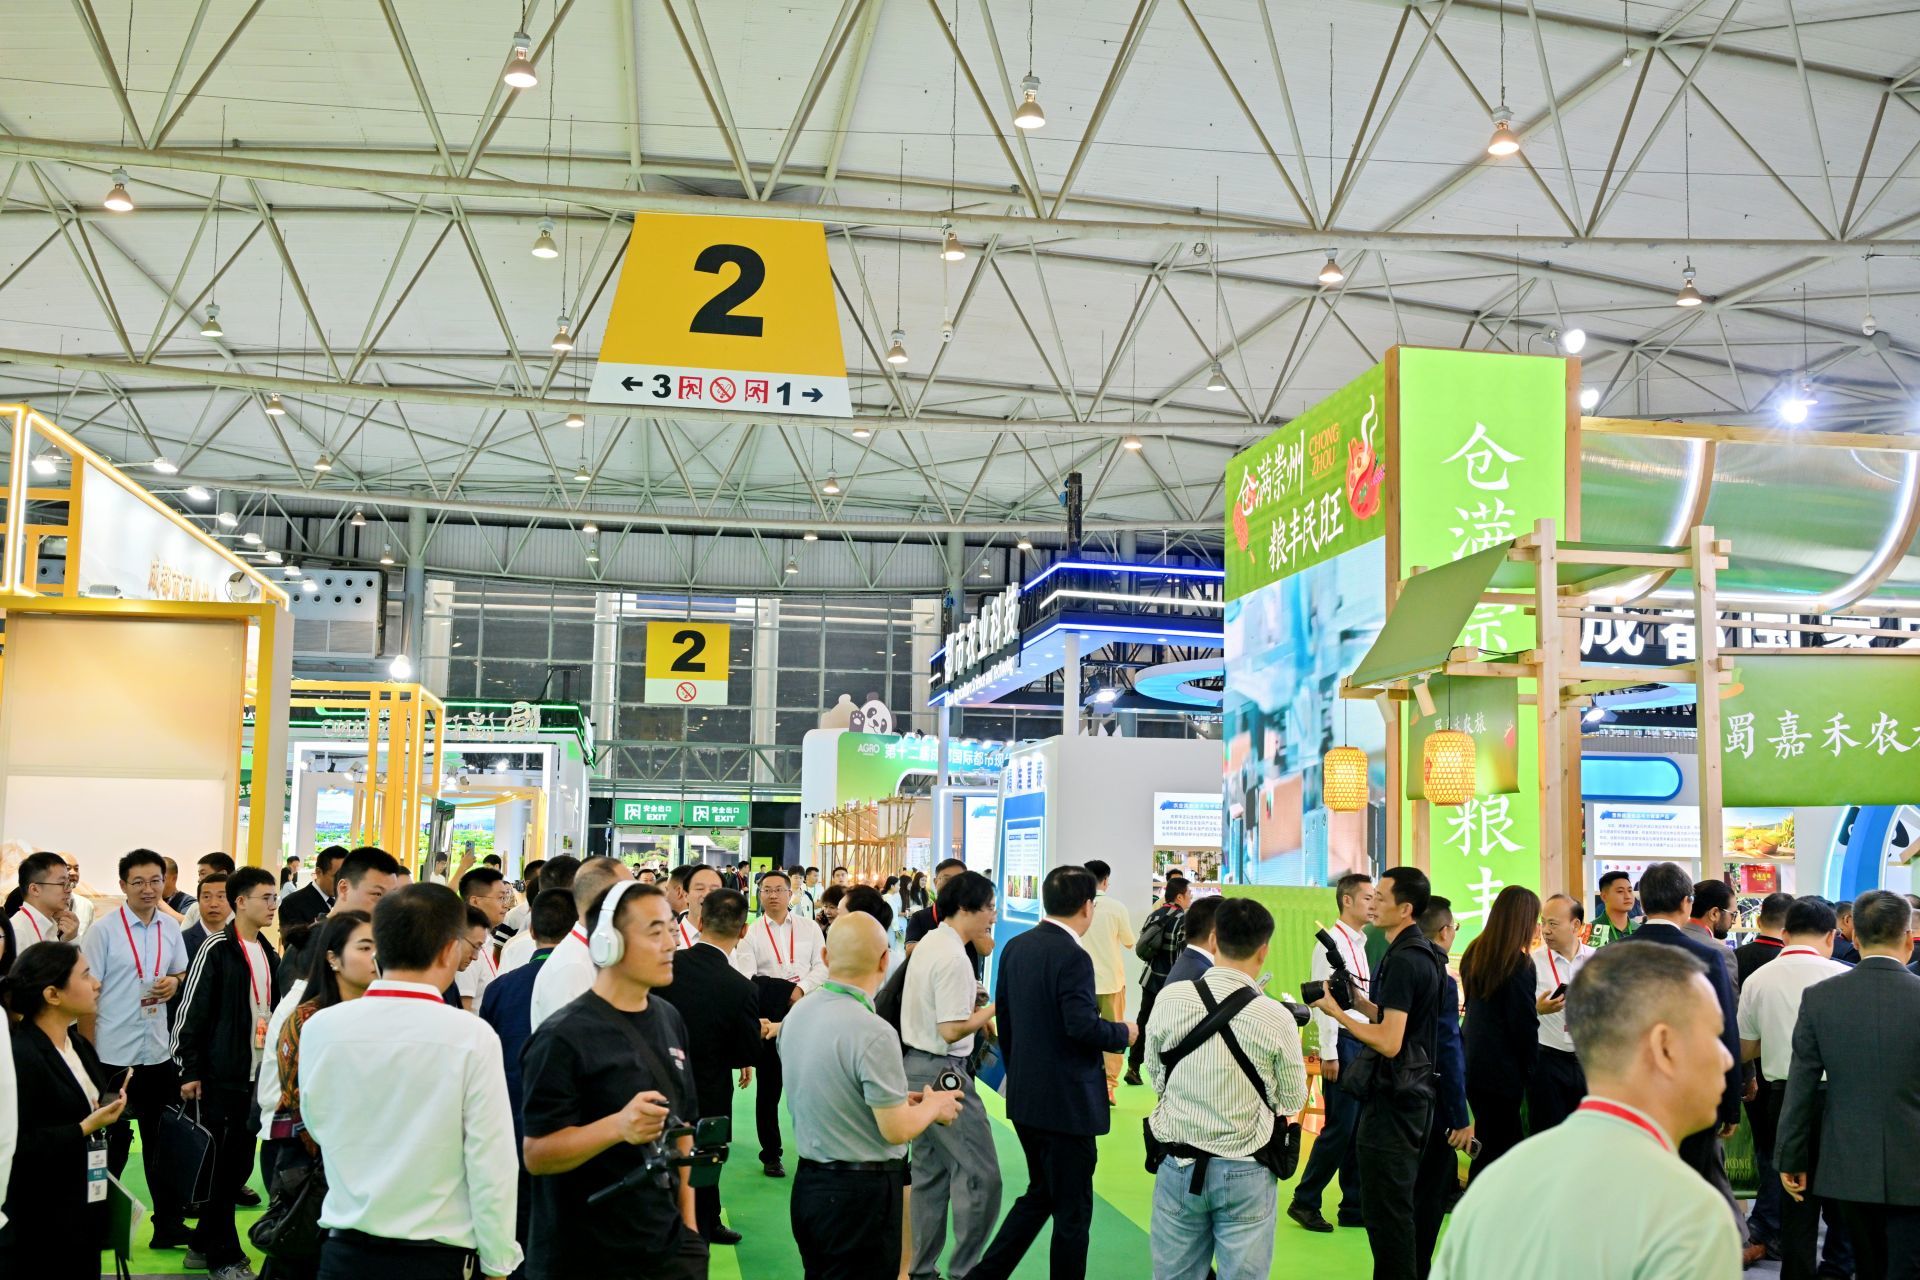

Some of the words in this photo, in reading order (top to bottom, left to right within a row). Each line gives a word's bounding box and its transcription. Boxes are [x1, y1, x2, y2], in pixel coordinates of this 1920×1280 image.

[689, 243, 766, 337] 2
[652, 374, 672, 399] 3
[776, 382, 791, 406] 1
[1309, 422, 1340, 457] CHONG
[1236, 429, 1305, 517] 仓满崇州
[1312, 446, 1336, 476] ZHOU
[1268, 487, 1344, 573] 粮丰民旺
[670, 629, 706, 673] 2
[857, 743, 880, 754] AGRO
[1725, 709, 1920, 760] 蜀嘉禾农
[643, 804, 672, 812] 安全出口
[646, 813, 667, 821] EXIT
[711, 806, 740, 814] 安全出口
